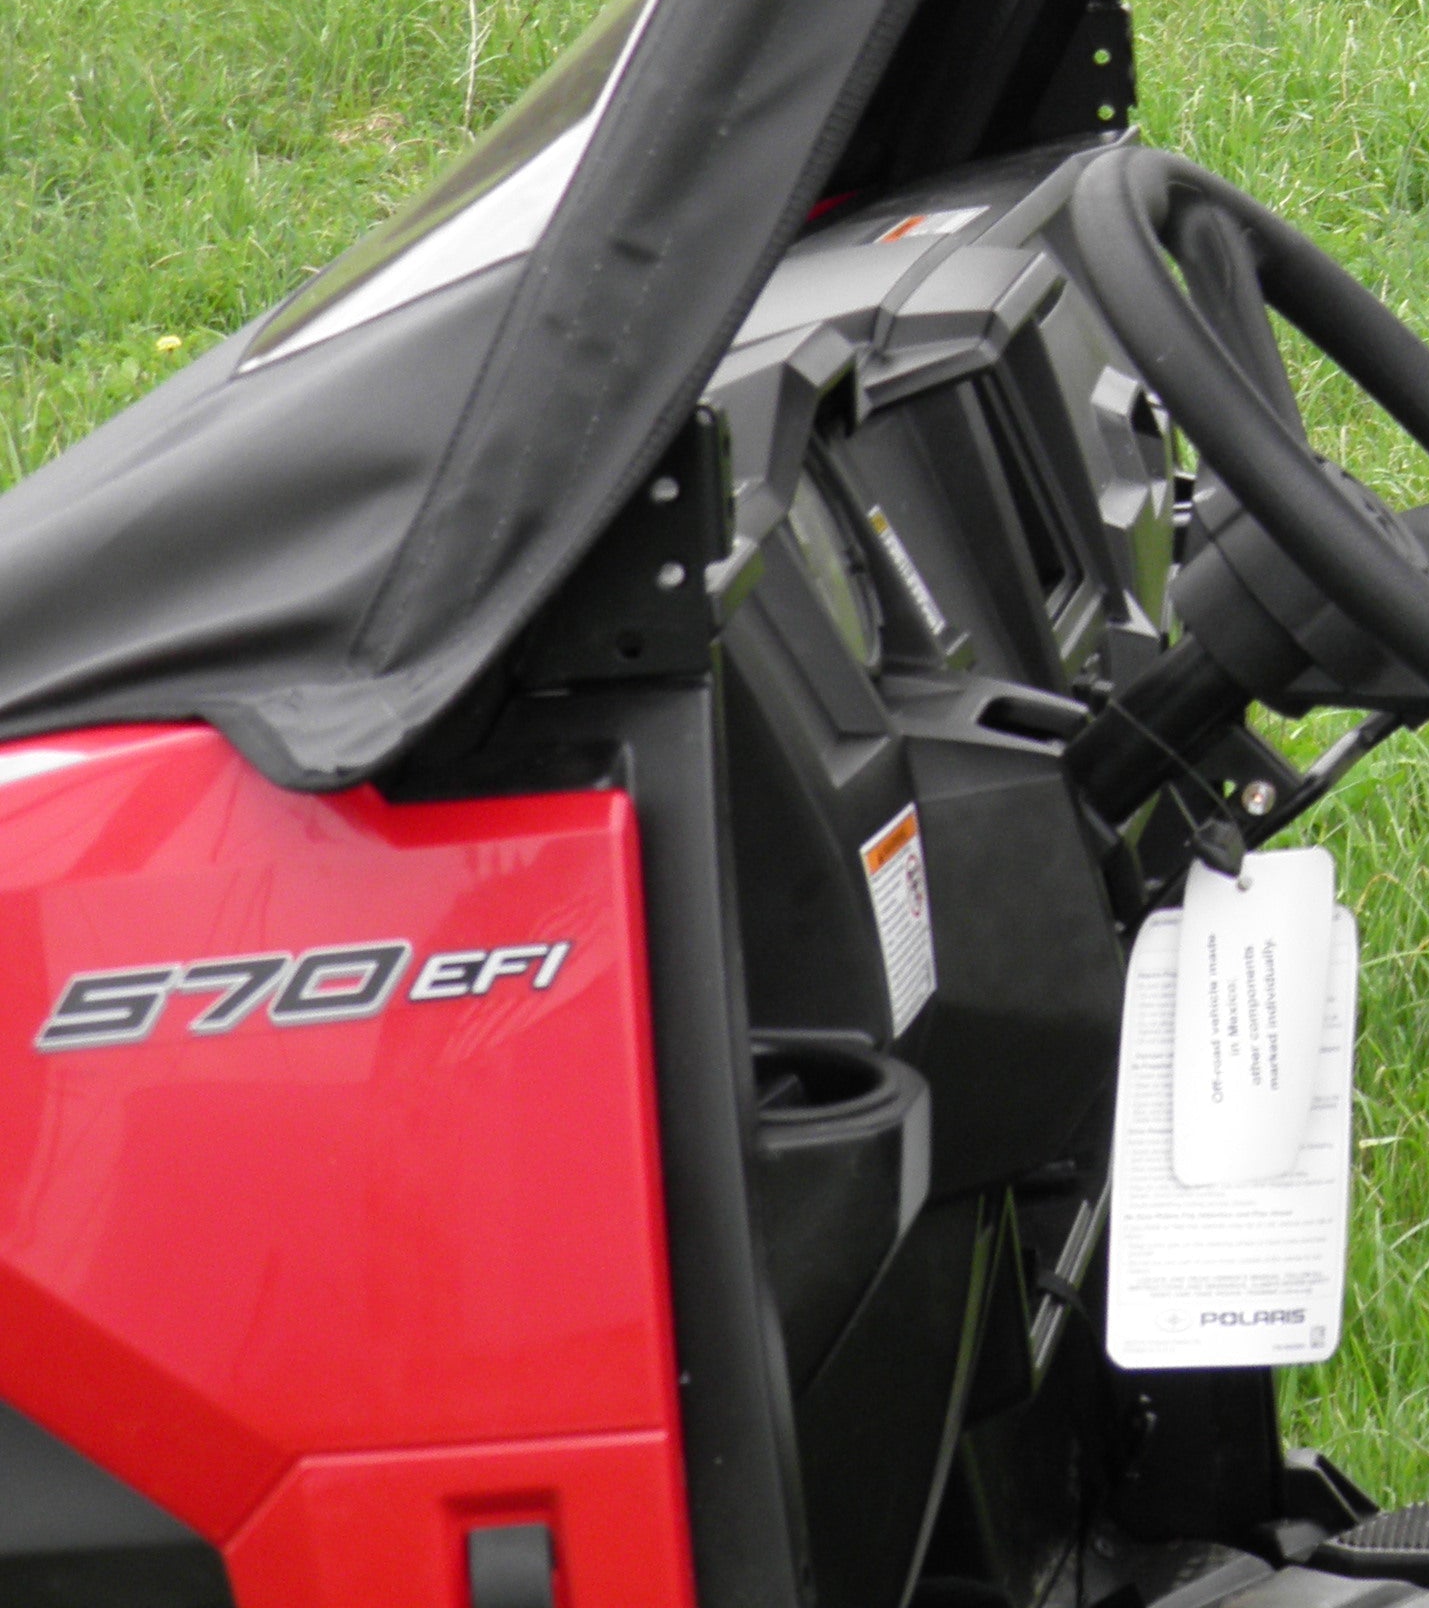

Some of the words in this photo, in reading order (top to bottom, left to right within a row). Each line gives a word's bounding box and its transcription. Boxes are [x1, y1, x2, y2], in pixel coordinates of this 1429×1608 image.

[1207, 932, 1217, 976] made
[34, 939, 412, 1054] 570
[409, 940, 572, 1001] EFI
[1209, 980, 1220, 1035] vehicle
[1244, 945, 1260, 1041] components
[1211, 1039, 1224, 1104] Off-road
[1229, 1041, 1240, 1057] in
[1250, 1045, 1262, 1086] other
[1268, 1033, 1280, 1091] marked
[1200, 1308, 1308, 1328] POLARIS
